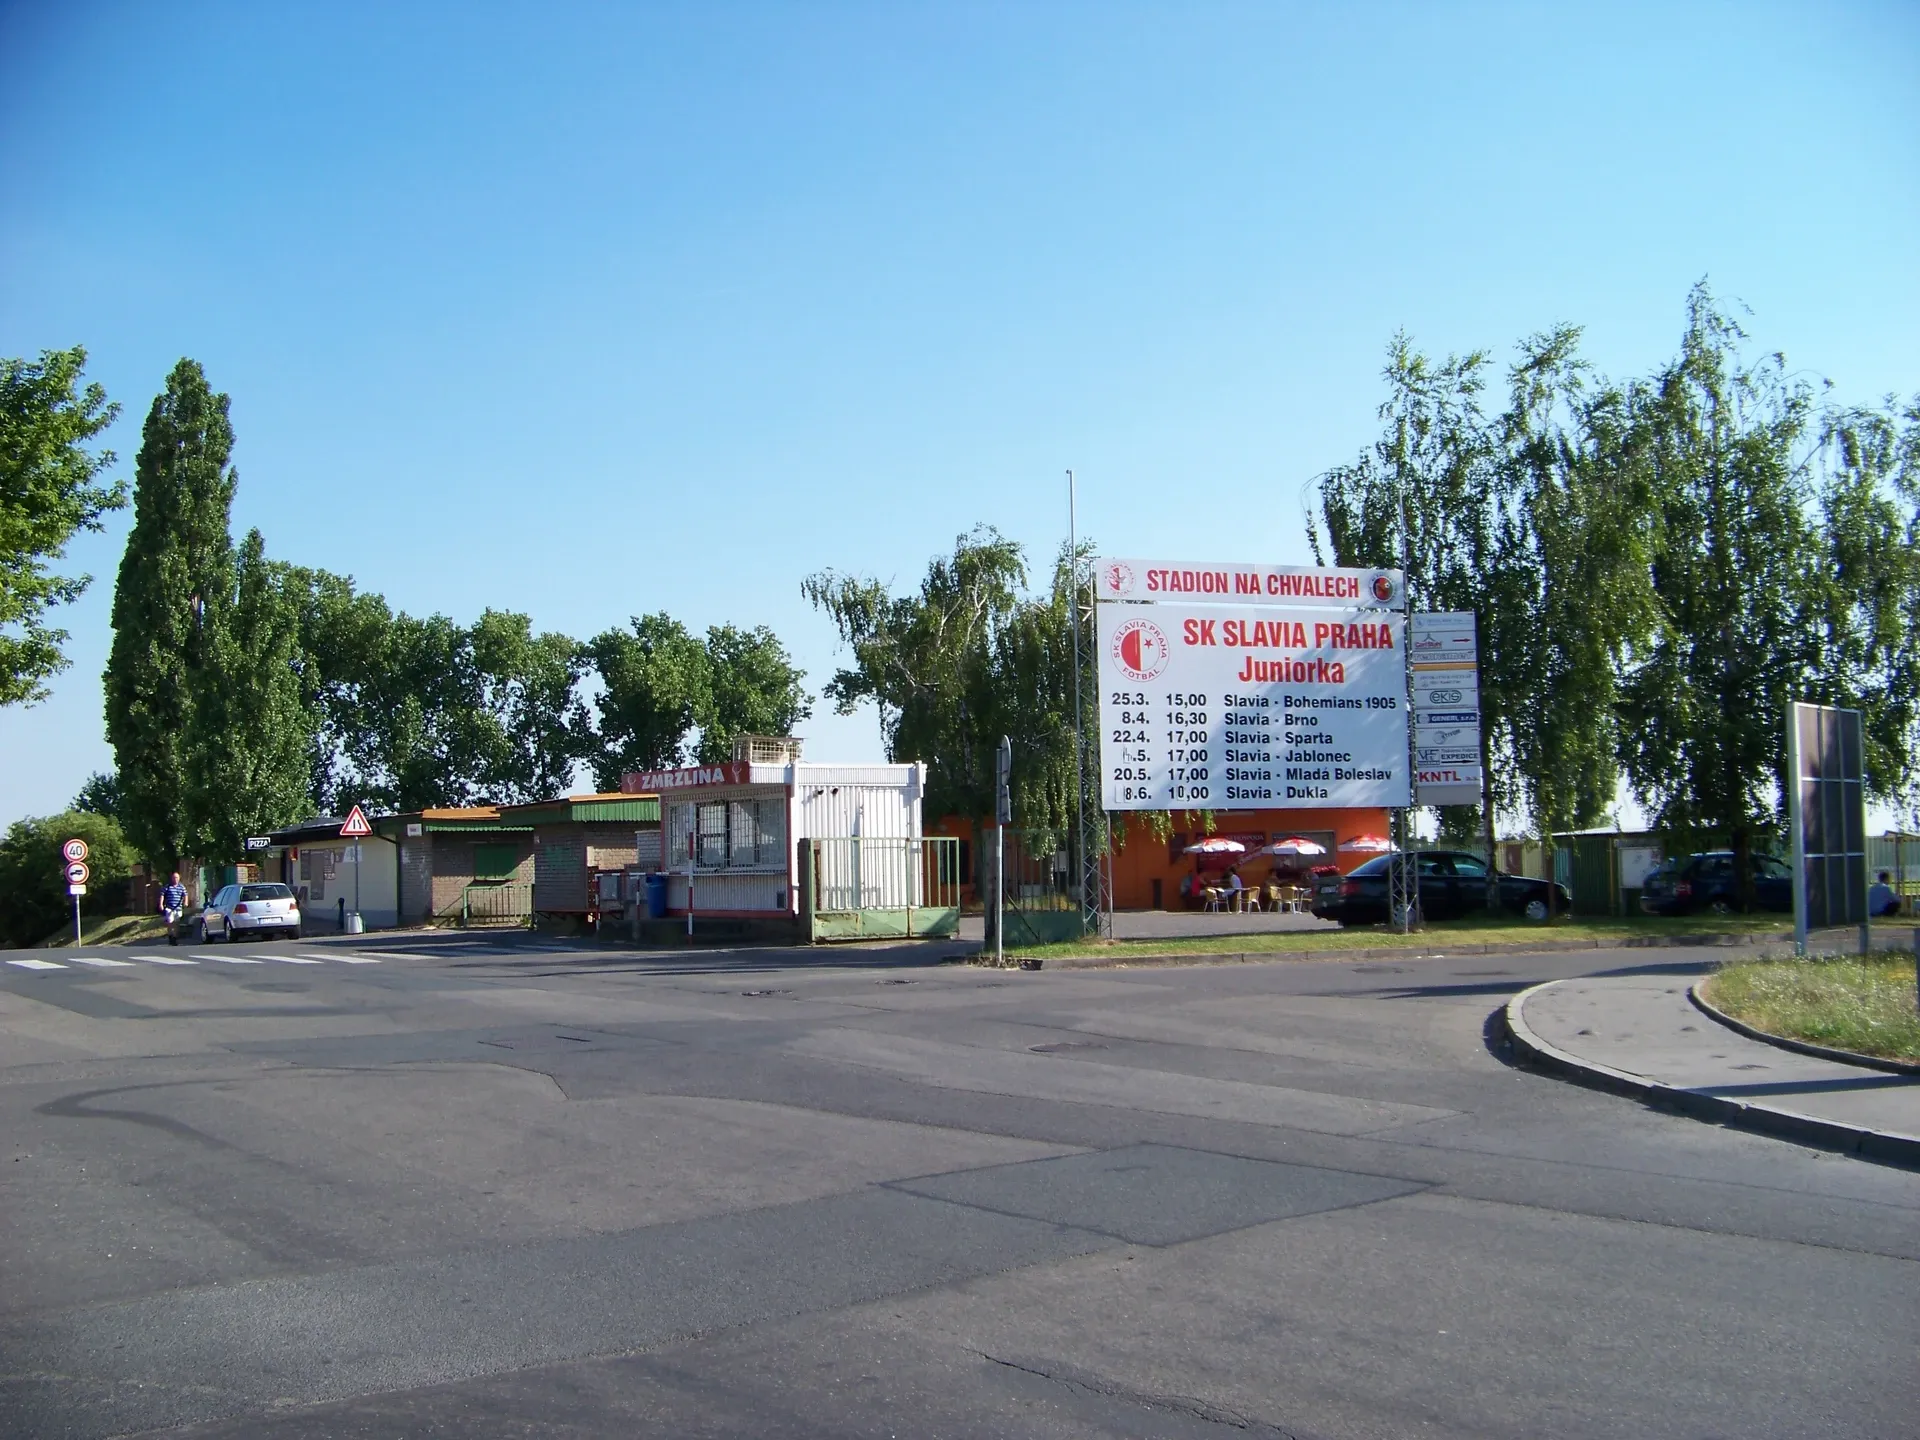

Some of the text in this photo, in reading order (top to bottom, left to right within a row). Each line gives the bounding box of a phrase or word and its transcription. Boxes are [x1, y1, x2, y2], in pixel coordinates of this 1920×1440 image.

[1146, 569, 1229, 593] STADION
[1235, 573, 1261, 595] NA
[1267, 574, 1359, 598] CHVALECH
[1113, 621, 1168, 659] SK SLAVIA PRAHA
[1183, 618, 1394, 649] SK SLAVIA PRAHA
[1122, 667, 1160, 680] FOTBAL
[1238, 656, 1345, 684] Juniorka
[1112, 692, 1149, 705] 25.3.
[1166, 693, 1207, 709] 15,00
[1224, 694, 1269, 707] Slavia
[1284, 695, 1363, 709] Bohemians
[1365, 697, 1397, 709] 1905
[1122, 711, 1150, 724] 8.4.
[1167, 712, 1207, 727] 16,30
[1225, 712, 1270, 726] Slavia
[1284, 713, 1318, 726] Brno
[1113, 730, 1150, 743] 22.4.
[1167, 730, 1208, 746] 17,00
[1225, 731, 1270, 744] Slavia
[1285, 732, 1333, 747] Sparta
[1167, 749, 1208, 764] 17,00
[1225, 749, 1271, 762] Slavia
[1285, 750, 1351, 763] Jablonec
[642, 767, 725, 789] ZMRZLINA
[1114, 768, 1151, 781] 20.5.
[1168, 768, 1208, 783] 17,00
[1226, 767, 1271, 781] Slavia
[1286, 767, 1330, 781] Mladá
[1334, 768, 1392, 781] Boleslav
[1419, 771, 1461, 782] KNTL
[1125, 786, 1152, 800] 8.6.
[1168, 786, 1209, 802] 10,00
[1226, 786, 1272, 799] Slavia
[1286, 786, 1328, 799] Dukla
[69, 845, 83, 856] 40
[250, 840, 268, 848] PIZZA
